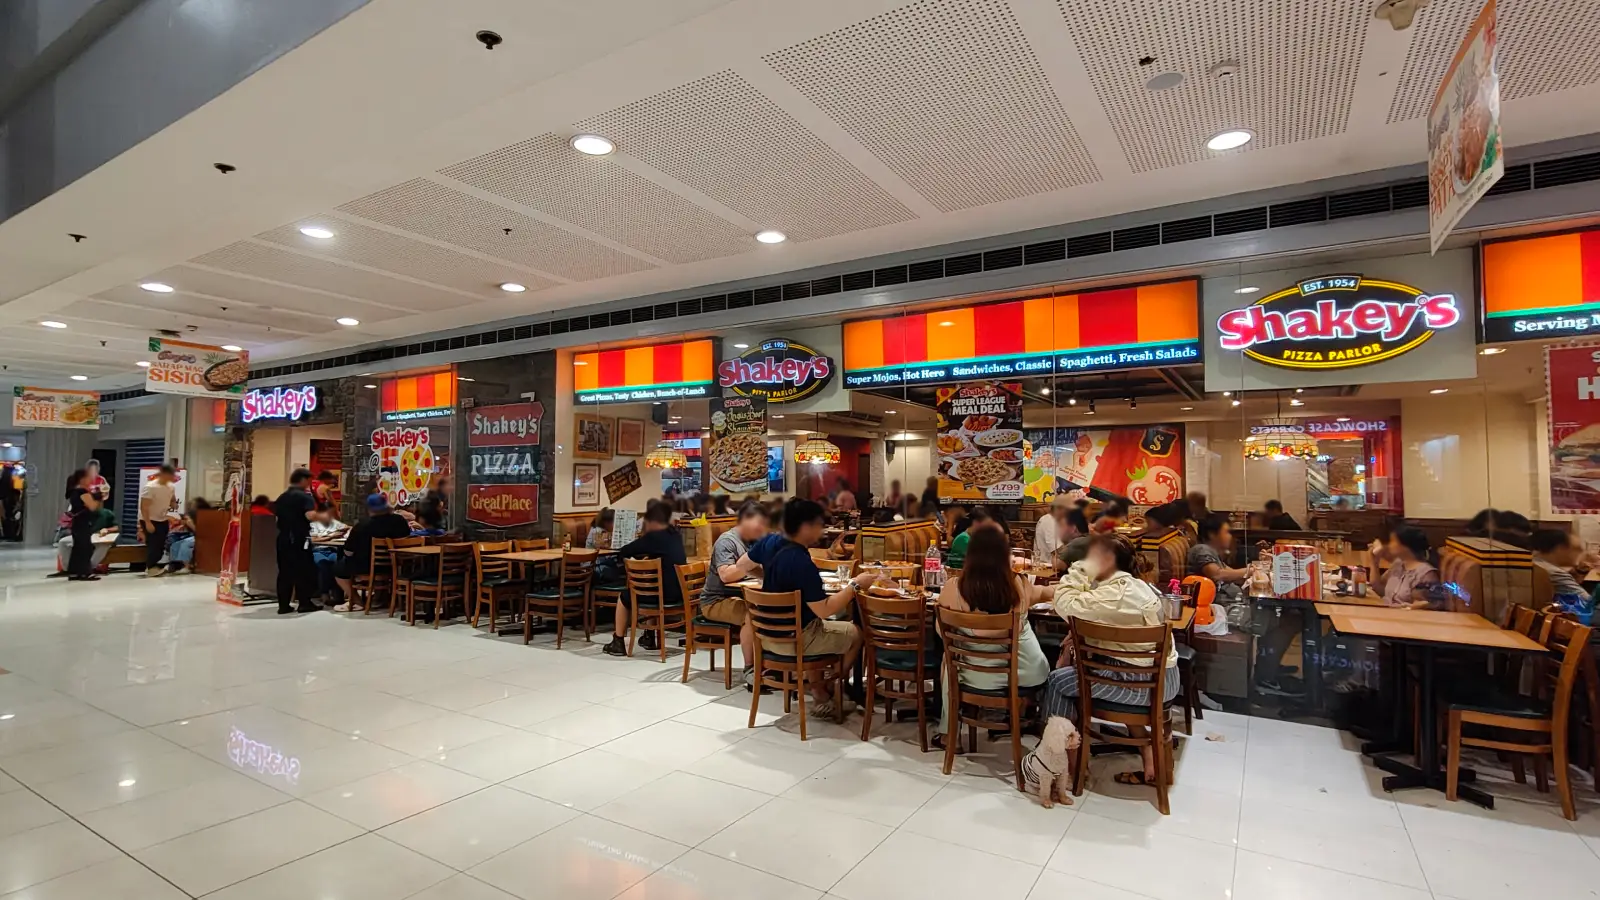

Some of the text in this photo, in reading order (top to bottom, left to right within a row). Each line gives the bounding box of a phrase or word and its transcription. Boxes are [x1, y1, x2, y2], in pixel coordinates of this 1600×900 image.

[1303, 278, 1356, 293] EST. 1954
[1217, 294, 1460, 350] Shakey's
[1514, 316, 1589, 333] Serving
[1282, 343, 1383, 361] PIZZA PARLOR
[718, 356, 830, 388] Shakey's
[847, 347, 1197, 386] Super Mojos, Hot Hero Sandwiches, Classic Spaghetti, Fresh Salads
[614, 392, 630, 401] Tasty
[631, 390, 656, 399] Chicken,
[773, 387, 798, 397] PARLOR
[960, 387, 998, 397] Shakey's
[242, 385, 317, 423] Shakey's
[952, 396, 1006, 407] SUPER LEAGUE
[952, 404, 1006, 416] MEAL DEAL
[472, 412, 538, 438] Shakey's
[371, 428, 429, 451] Shakey's
[470, 452, 536, 475] PIZZA
[471, 493, 533, 512] Great Place
